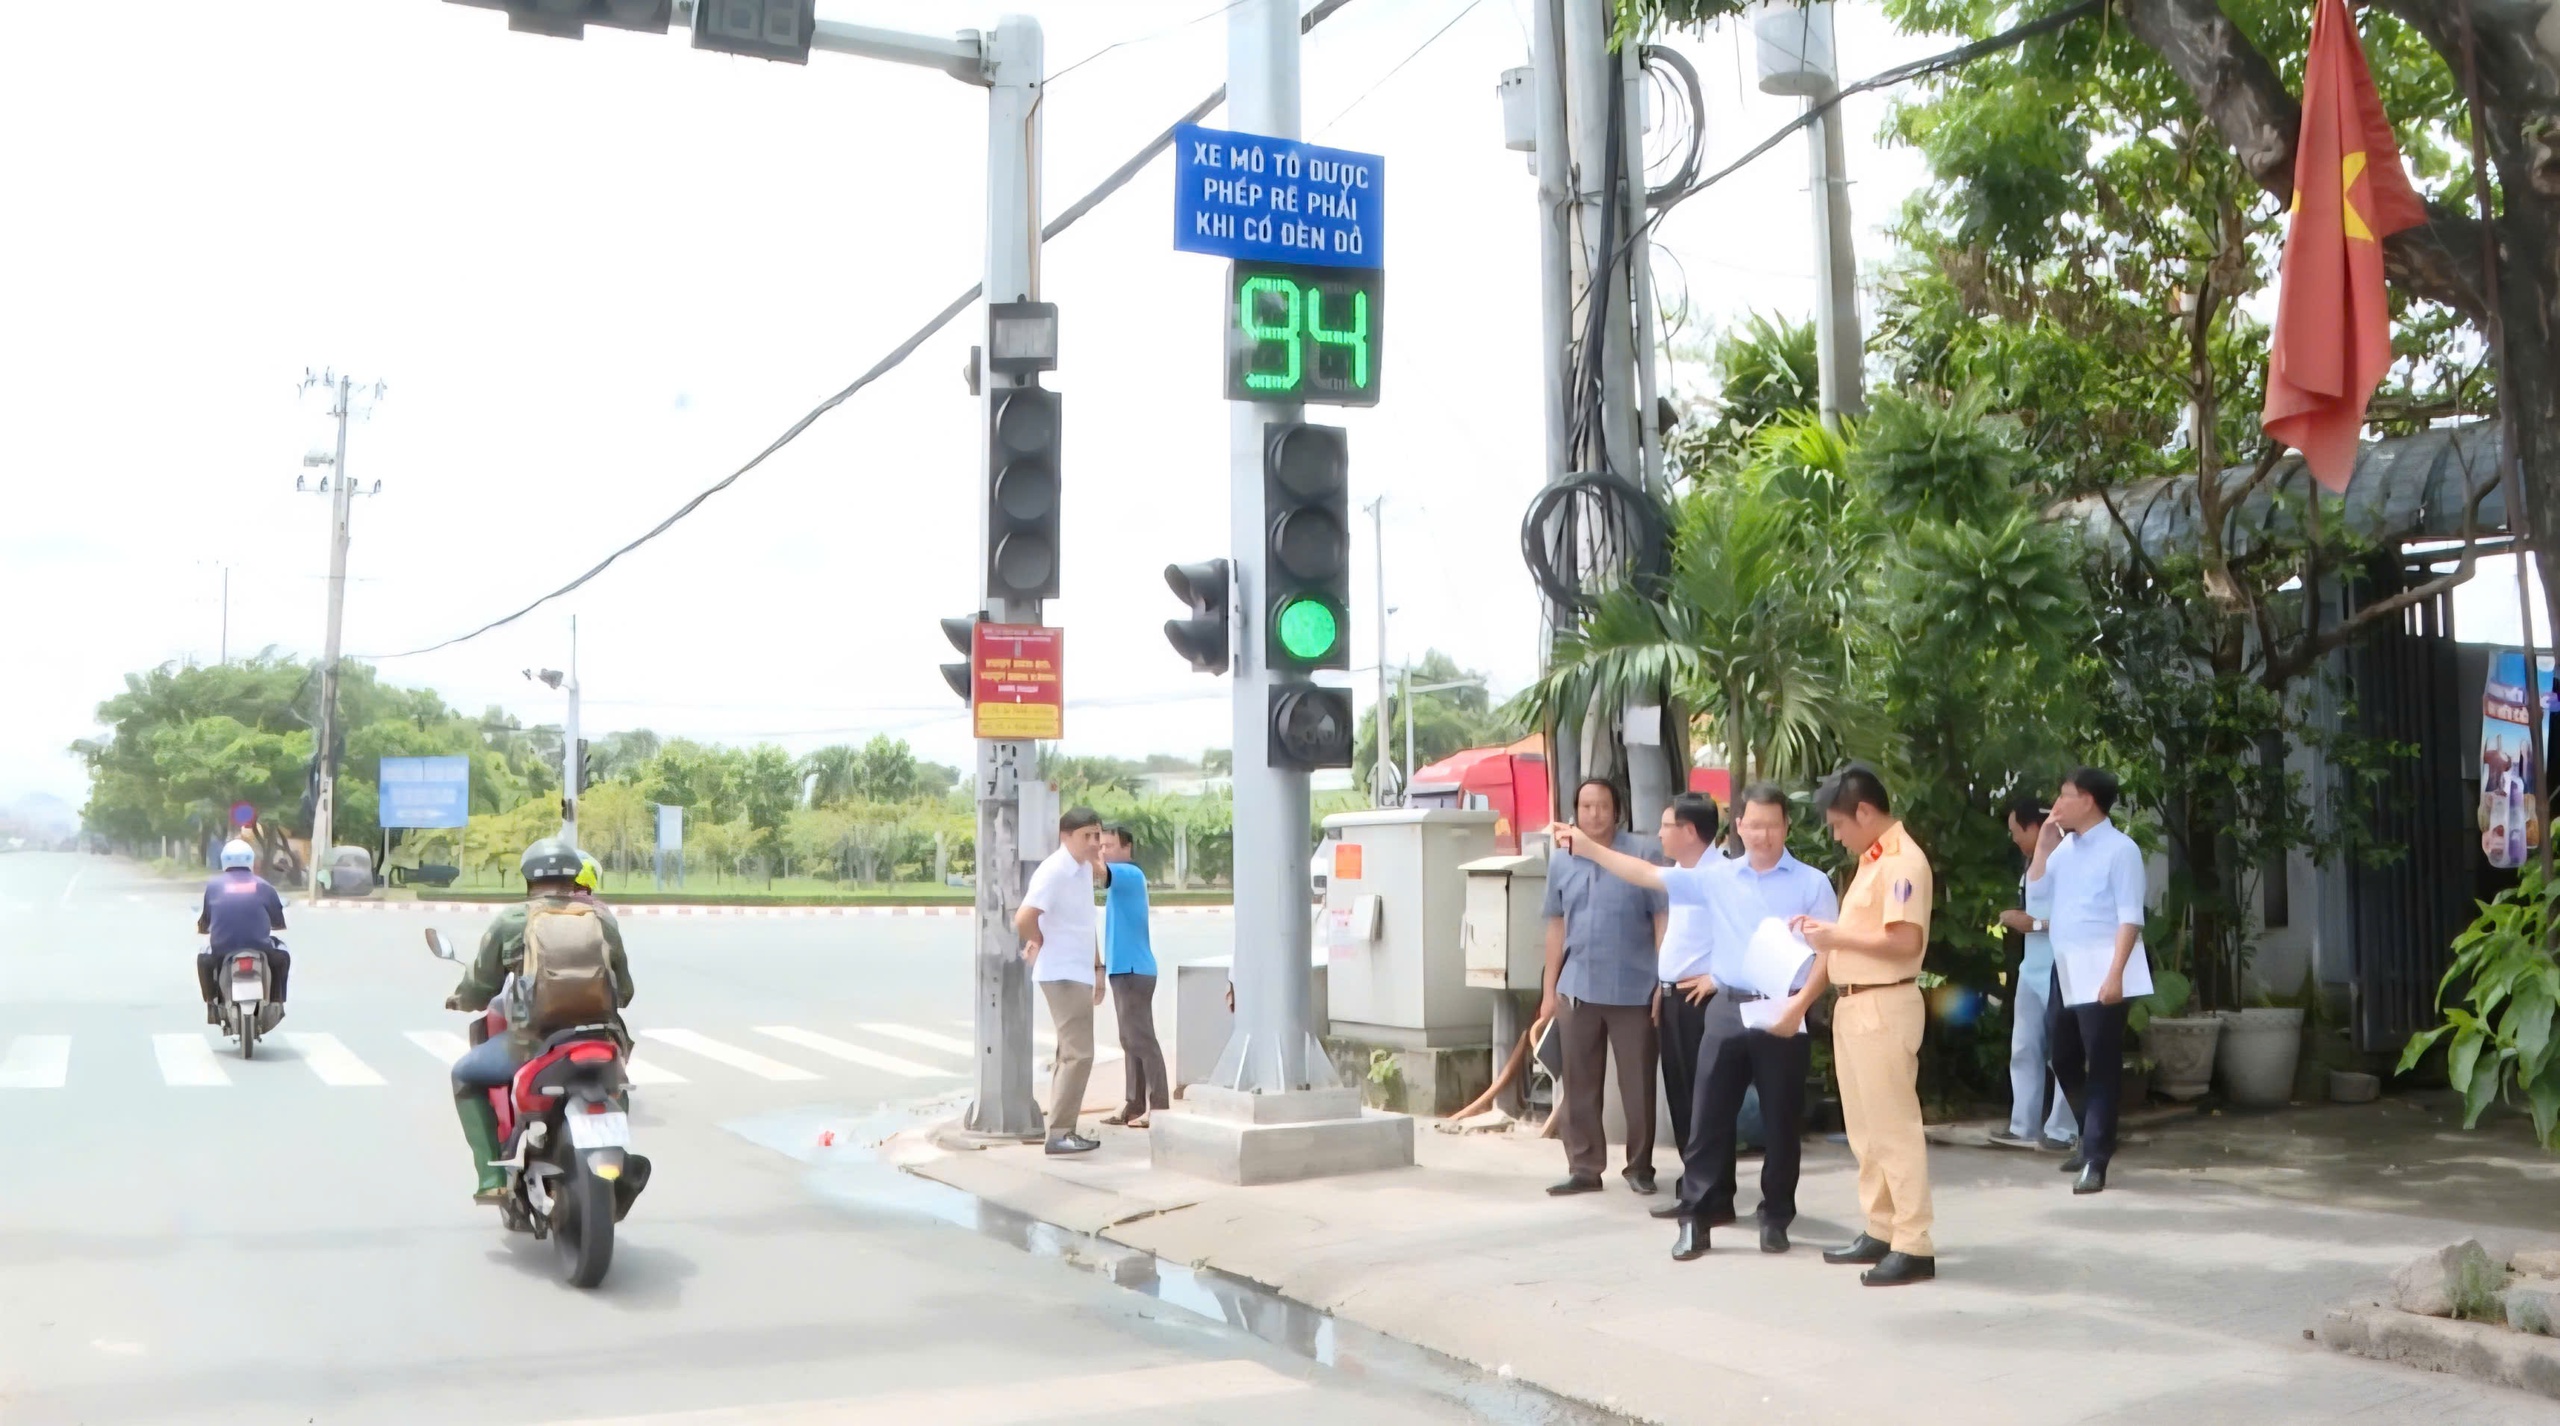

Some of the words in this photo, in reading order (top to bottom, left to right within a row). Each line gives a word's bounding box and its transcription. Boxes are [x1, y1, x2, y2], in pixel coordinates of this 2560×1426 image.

[1193, 141, 1222, 168] XE
[1230, 145, 1265, 173] MÔ
[1273, 151, 1300, 178] TÔ
[1204, 176, 1263, 207] PHÉP
[1308, 190, 1357, 221] PHẢI
[1196, 210, 1235, 239] KHI
[1243, 213, 1272, 243] CÓ
[1240, 276, 1367, 389] 94
